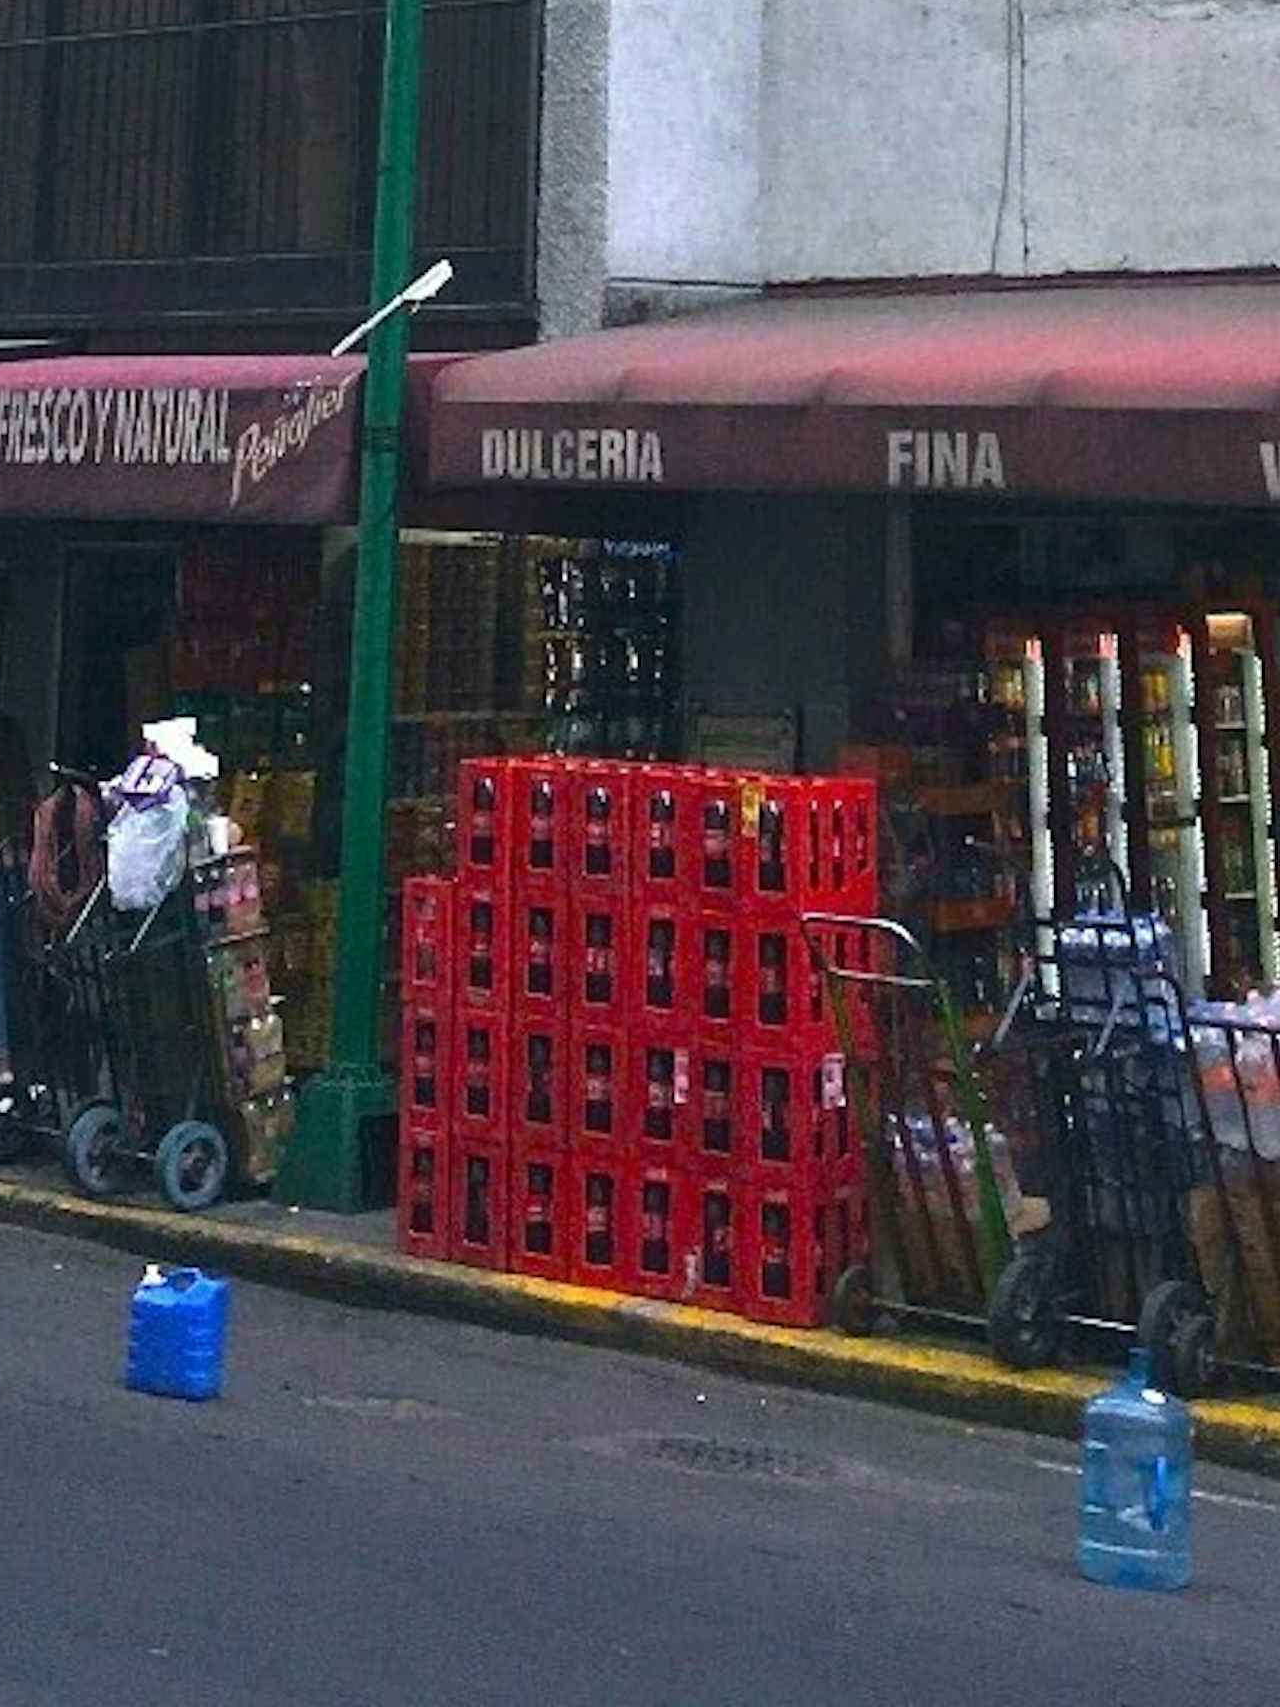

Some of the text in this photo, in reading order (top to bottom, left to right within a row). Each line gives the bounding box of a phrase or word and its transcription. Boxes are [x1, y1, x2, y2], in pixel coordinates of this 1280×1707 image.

[93, 387, 114, 464] Y
[114, 387, 231, 467] NATURAL
[482, 428, 663, 482] DULCERIA
[888, 431, 1007, 489] FINA
